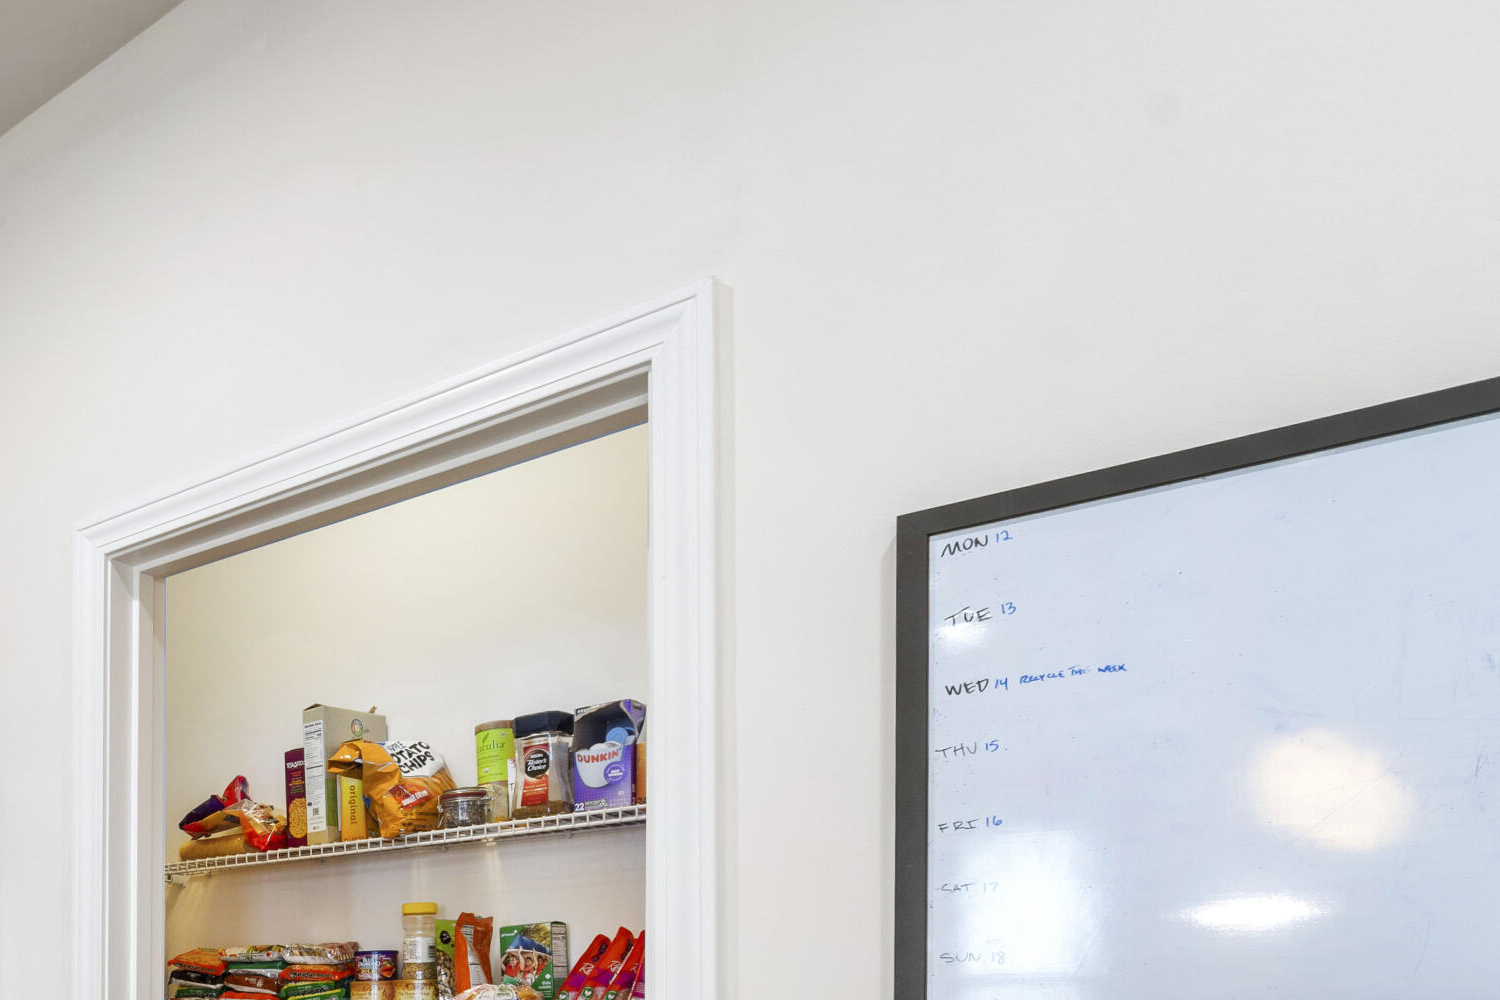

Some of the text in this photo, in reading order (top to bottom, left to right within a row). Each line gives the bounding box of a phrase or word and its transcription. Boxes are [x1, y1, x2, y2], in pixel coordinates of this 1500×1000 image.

[940, 529, 1015, 558] MON 12
[944, 601, 1017, 627] TUE 13
[945, 678, 989, 696] WED
[994, 677, 1009, 691] 14
[1097, 663, 1128, 673] WEEK
[935, 739, 1000, 759] THU 15
[398, 750, 435, 774] CHIPS
[349, 784, 358, 825] original
[573, 802, 585, 812] 22
[938, 815, 1003, 833] FRI 16
[940, 951, 981, 964] SUN
